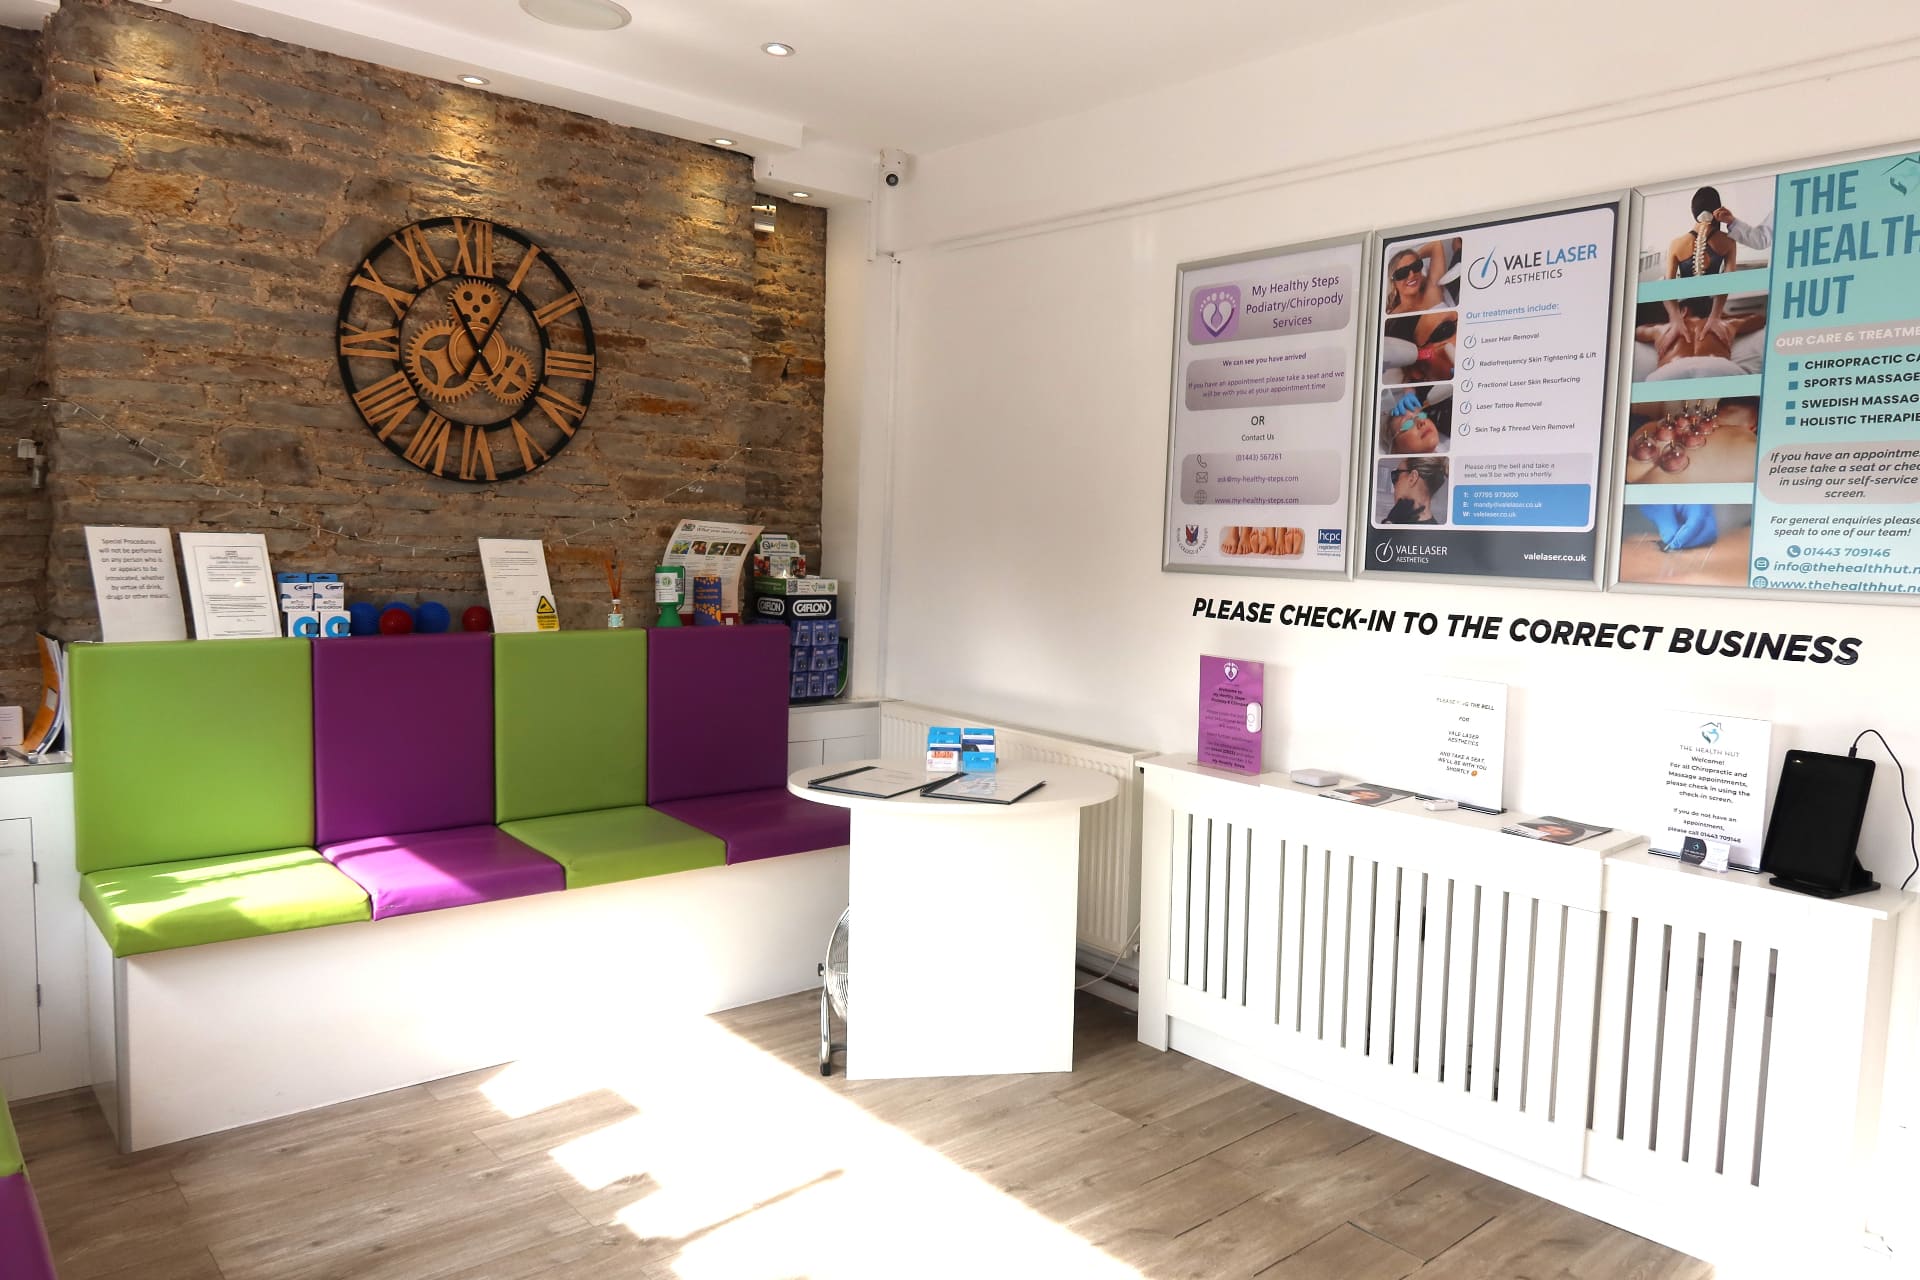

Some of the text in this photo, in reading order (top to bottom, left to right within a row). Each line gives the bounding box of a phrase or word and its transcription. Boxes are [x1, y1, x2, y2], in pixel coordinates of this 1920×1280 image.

[1790, 170, 1859, 217] THE
[1787, 214, 1920, 269] HEALTH
[1504, 244, 1597, 270] VALE LASER
[1504, 269, 1562, 285] AESTHETICS
[1252, 275, 1339, 297] My Healthy Steps
[1783, 274, 1854, 319] HUT
[1246, 293, 1343, 315] Podiatry/Chiropody
[1466, 303, 1559, 320] Our treatments include:
[1273, 316, 1312, 329] Services
[1499, 335, 1512, 343] Hair
[1513, 333, 1539, 341] Removal
[1776, 337, 1803, 347] OUR
[1806, 333, 1841, 345] CARE
[1844, 332, 1854, 342] &
[1233, 358, 1244, 366] can
[1256, 357, 1268, 366] you
[1269, 354, 1283, 363] have
[1284, 352, 1307, 361] arrived
[1479, 358, 1527, 367] Radiofrequency
[1529, 355, 1542, 363] Skin
[1543, 353, 1577, 362] Tightening
[1804, 354, 1902, 370] CHIROPRACTIC
[1478, 381, 1508, 389] Fractional
[1528, 378, 1541, 386] Skin
[1543, 376, 1581, 384] Resurfacing
[1804, 372, 1920, 388] SPORTS MASSAGE
[1801, 397, 1859, 409] SWEDISH
[1250, 415, 1265, 426] OR
[1800, 416, 1856, 427] HOLISTIC
[1490, 426, 1501, 434] Tag
[1241, 433, 1275, 442] Contact Us
[1770, 452, 1779, 463] If
[1780, 453, 1801, 463] you
[1804, 451, 1832, 460] have
[1835, 452, 1850, 460] an
[1769, 464, 1807, 476] please
[1810, 463, 1836, 473] take
[1849, 463, 1875, 472] seat
[1779, 475, 1918, 487] in using our self-service
[1824, 490, 1866, 498] screen.
[1770, 516, 1787, 524] For
[1789, 516, 1829, 526] general
[1832, 516, 1882, 526] enquiries
[1320, 530, 1341, 543] hcpc
[1774, 527, 1805, 537] speak
[1808, 528, 1818, 536] to
[1843, 527, 1857, 538] of
[1857, 529, 1875, 537] our
[1878, 528, 1912, 537] team!
[1396, 545, 1448, 556] VALE LASER
[1803, 547, 1892, 558] 01443 709146
[1396, 556, 1429, 564] AESTHETICS
[1523, 552, 1587, 563] valelaser.co.uk
[796, 603, 826, 613] CAFLON
[1193, 597, 1863, 666] PLEASE CHECK-IN TO THE CORRECT BUSINESS
[1696, 747, 1722, 755] HEALTH
[1691, 756, 1725, 765] Welcome!
[1668, 770, 1697, 780] Massage
[1691, 765, 1732, 776] Chiropractic
[1666, 779, 1687, 788] please
[1689, 782, 1709, 791] check
[1718, 787, 1737, 797] using
